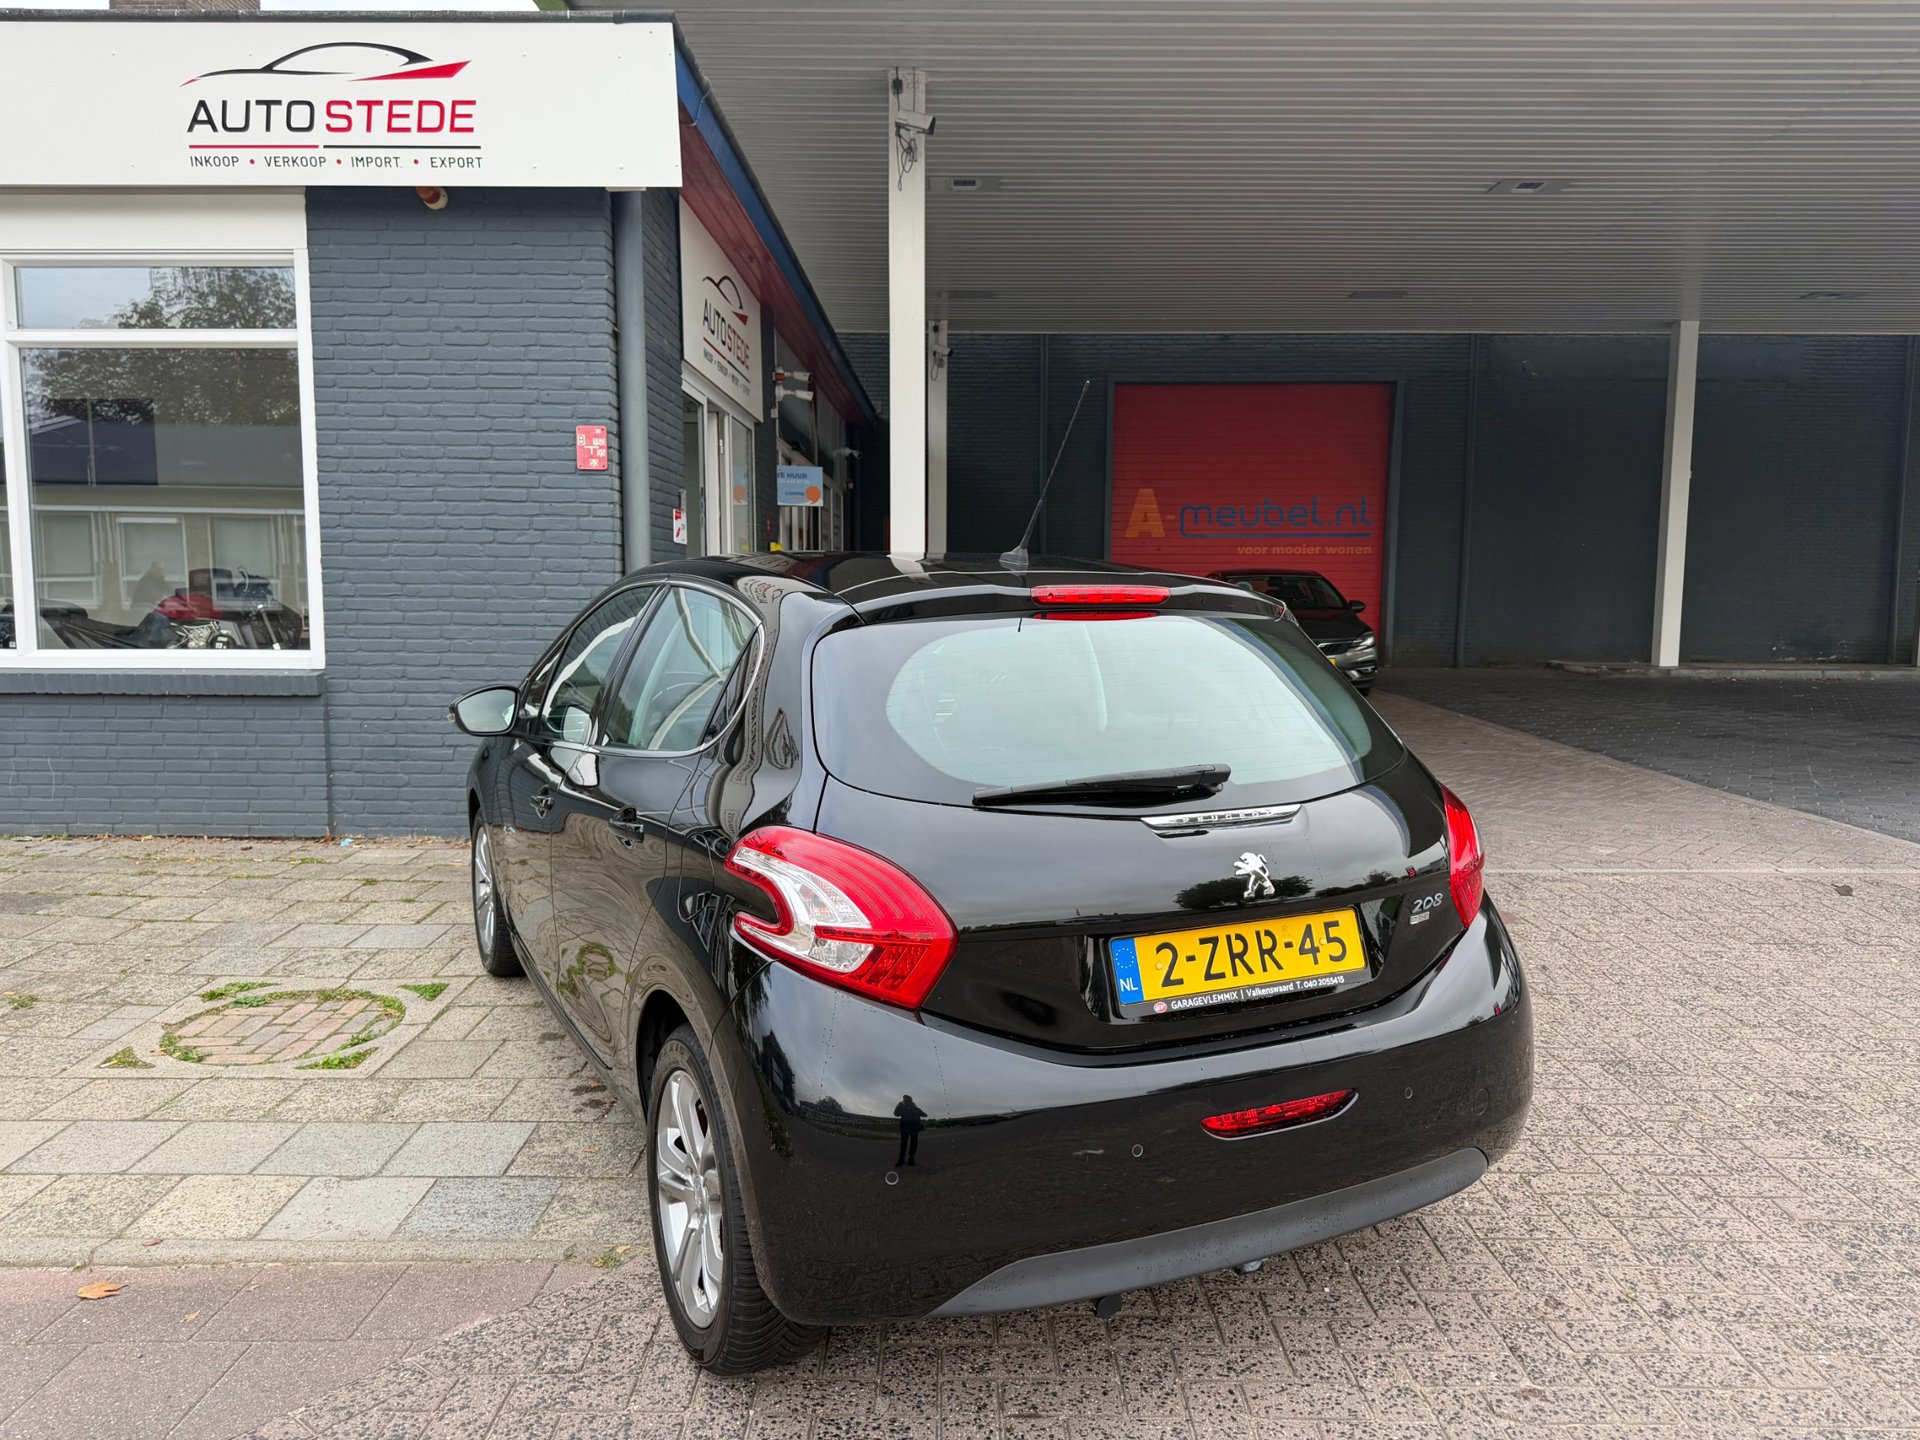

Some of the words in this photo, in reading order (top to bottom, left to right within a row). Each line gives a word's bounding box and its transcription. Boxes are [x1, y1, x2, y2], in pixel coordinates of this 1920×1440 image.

[190, 155, 240, 168] INKOOP
[264, 156, 327, 168] VERKOOP
[430, 156, 483, 169] EXPORT
[1125, 488, 1372, 538] A-meubel.nl
[1237, 545, 1268, 555] voor
[1272, 543, 1322, 555] mooier
[1325, 545, 1372, 555] wonen
[1411, 892, 1443, 914] 208
[1155, 920, 1347, 988] 2-ZRR-45
[1119, 977, 1138, 992] NL
[1171, 991, 1239, 1010] GARAGEVLEMMIX
[1246, 982, 1294, 998] Valkenswaard
